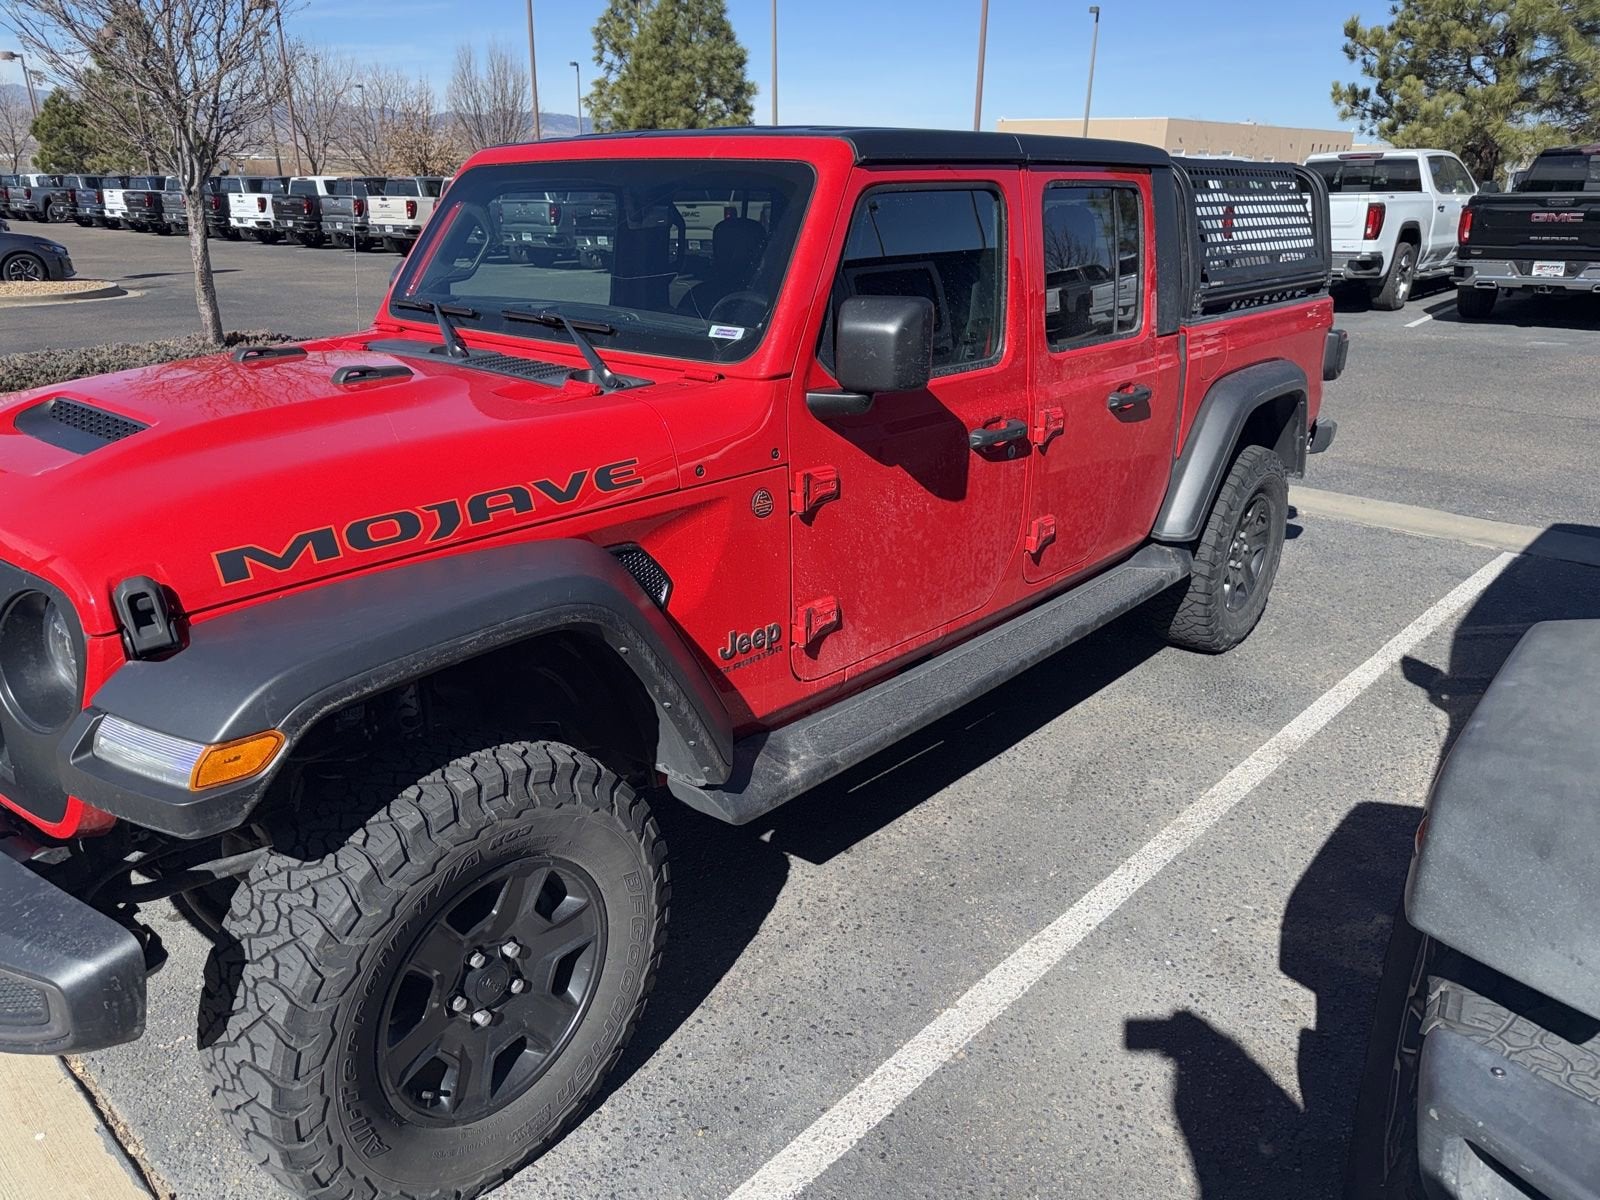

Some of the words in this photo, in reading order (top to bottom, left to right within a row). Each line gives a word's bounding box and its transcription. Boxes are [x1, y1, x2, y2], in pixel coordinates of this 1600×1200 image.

[1530, 212, 1585, 223] GMC
[210, 457, 646, 587] MOJAVE
[718, 622, 781, 660] Jeep
